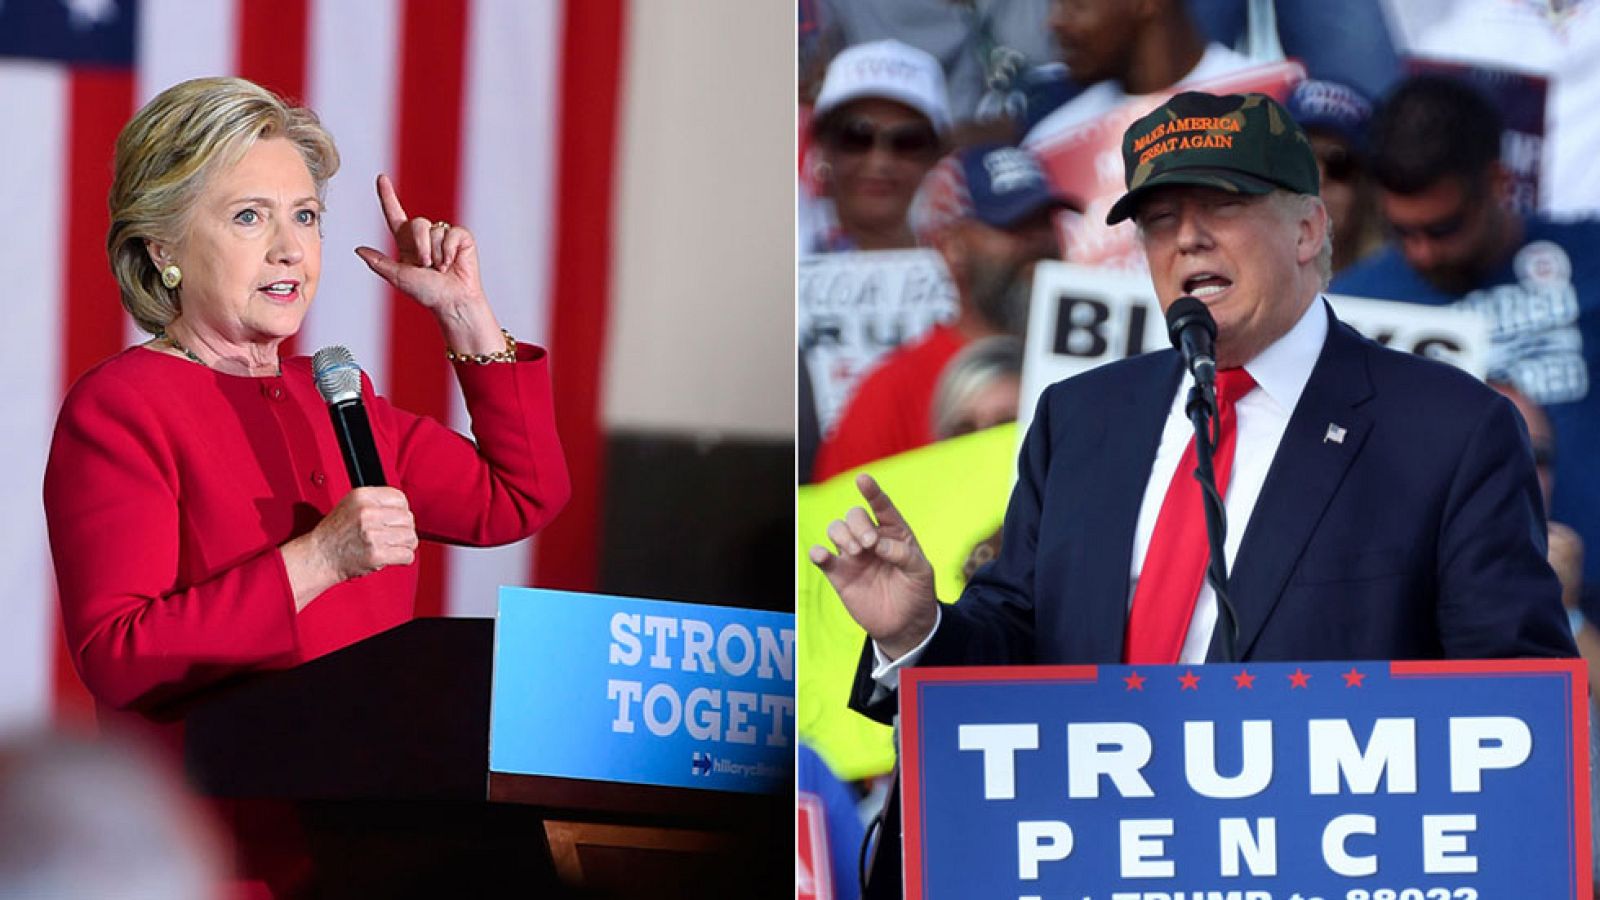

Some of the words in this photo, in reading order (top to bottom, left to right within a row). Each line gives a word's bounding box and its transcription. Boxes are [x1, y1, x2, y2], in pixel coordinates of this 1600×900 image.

[1139, 137, 1179, 165] GREAT
[1180, 134, 1233, 149] AGAIN
[1166, 117, 1240, 133] AMERICA
[608, 611, 796, 682] STRON
[607, 678, 796, 747] TOGET
[957, 716, 1534, 800] TRUMP
[1017, 813, 1479, 880] PENCE
